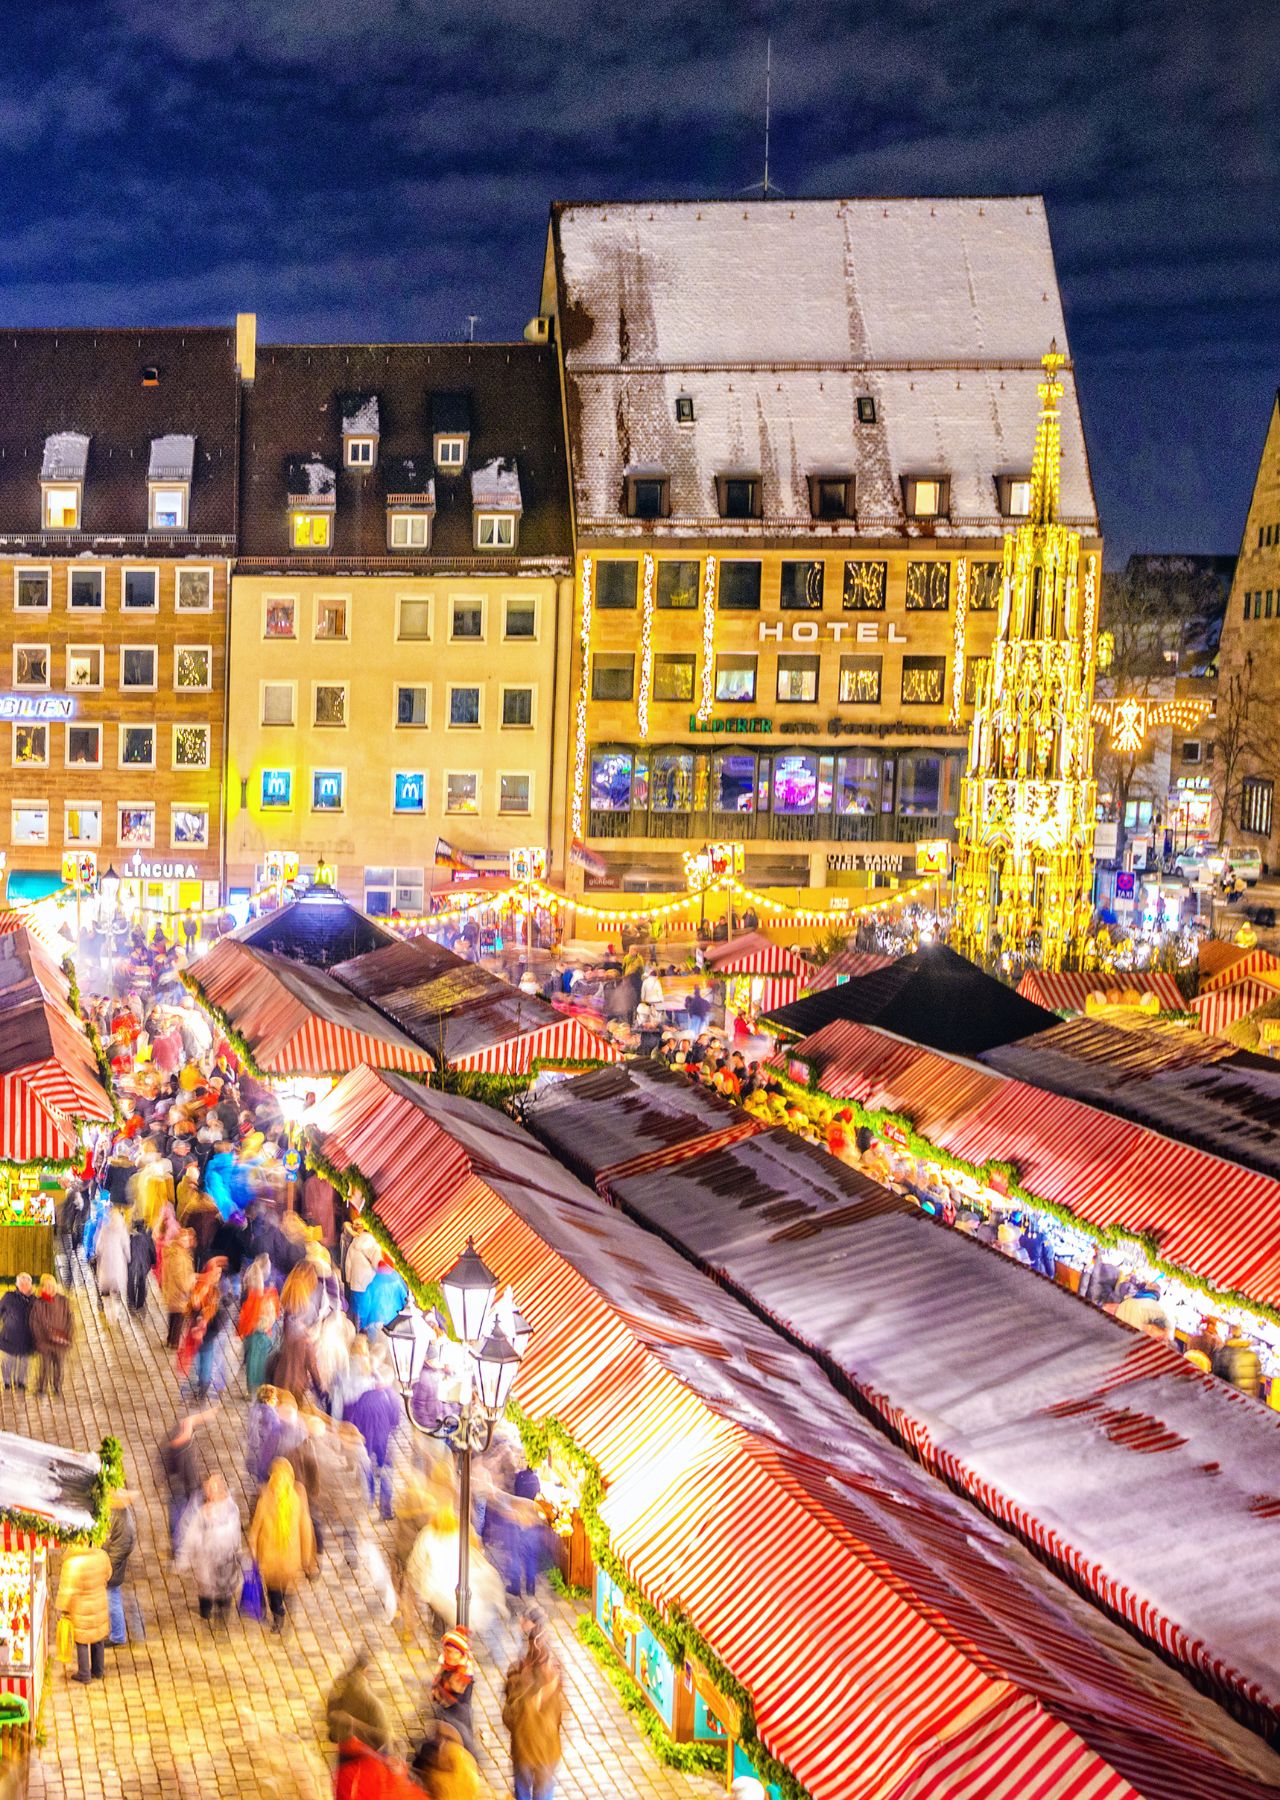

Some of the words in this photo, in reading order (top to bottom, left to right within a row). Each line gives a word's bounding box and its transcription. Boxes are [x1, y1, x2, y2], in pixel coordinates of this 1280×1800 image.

[759, 621, 907, 643] HOTEL
[780, 721, 818, 734] am
[863, 854, 902, 865] GARNI
[124, 864, 196, 878] LINCURA
[1117, 890, 1133, 898] TAXI
